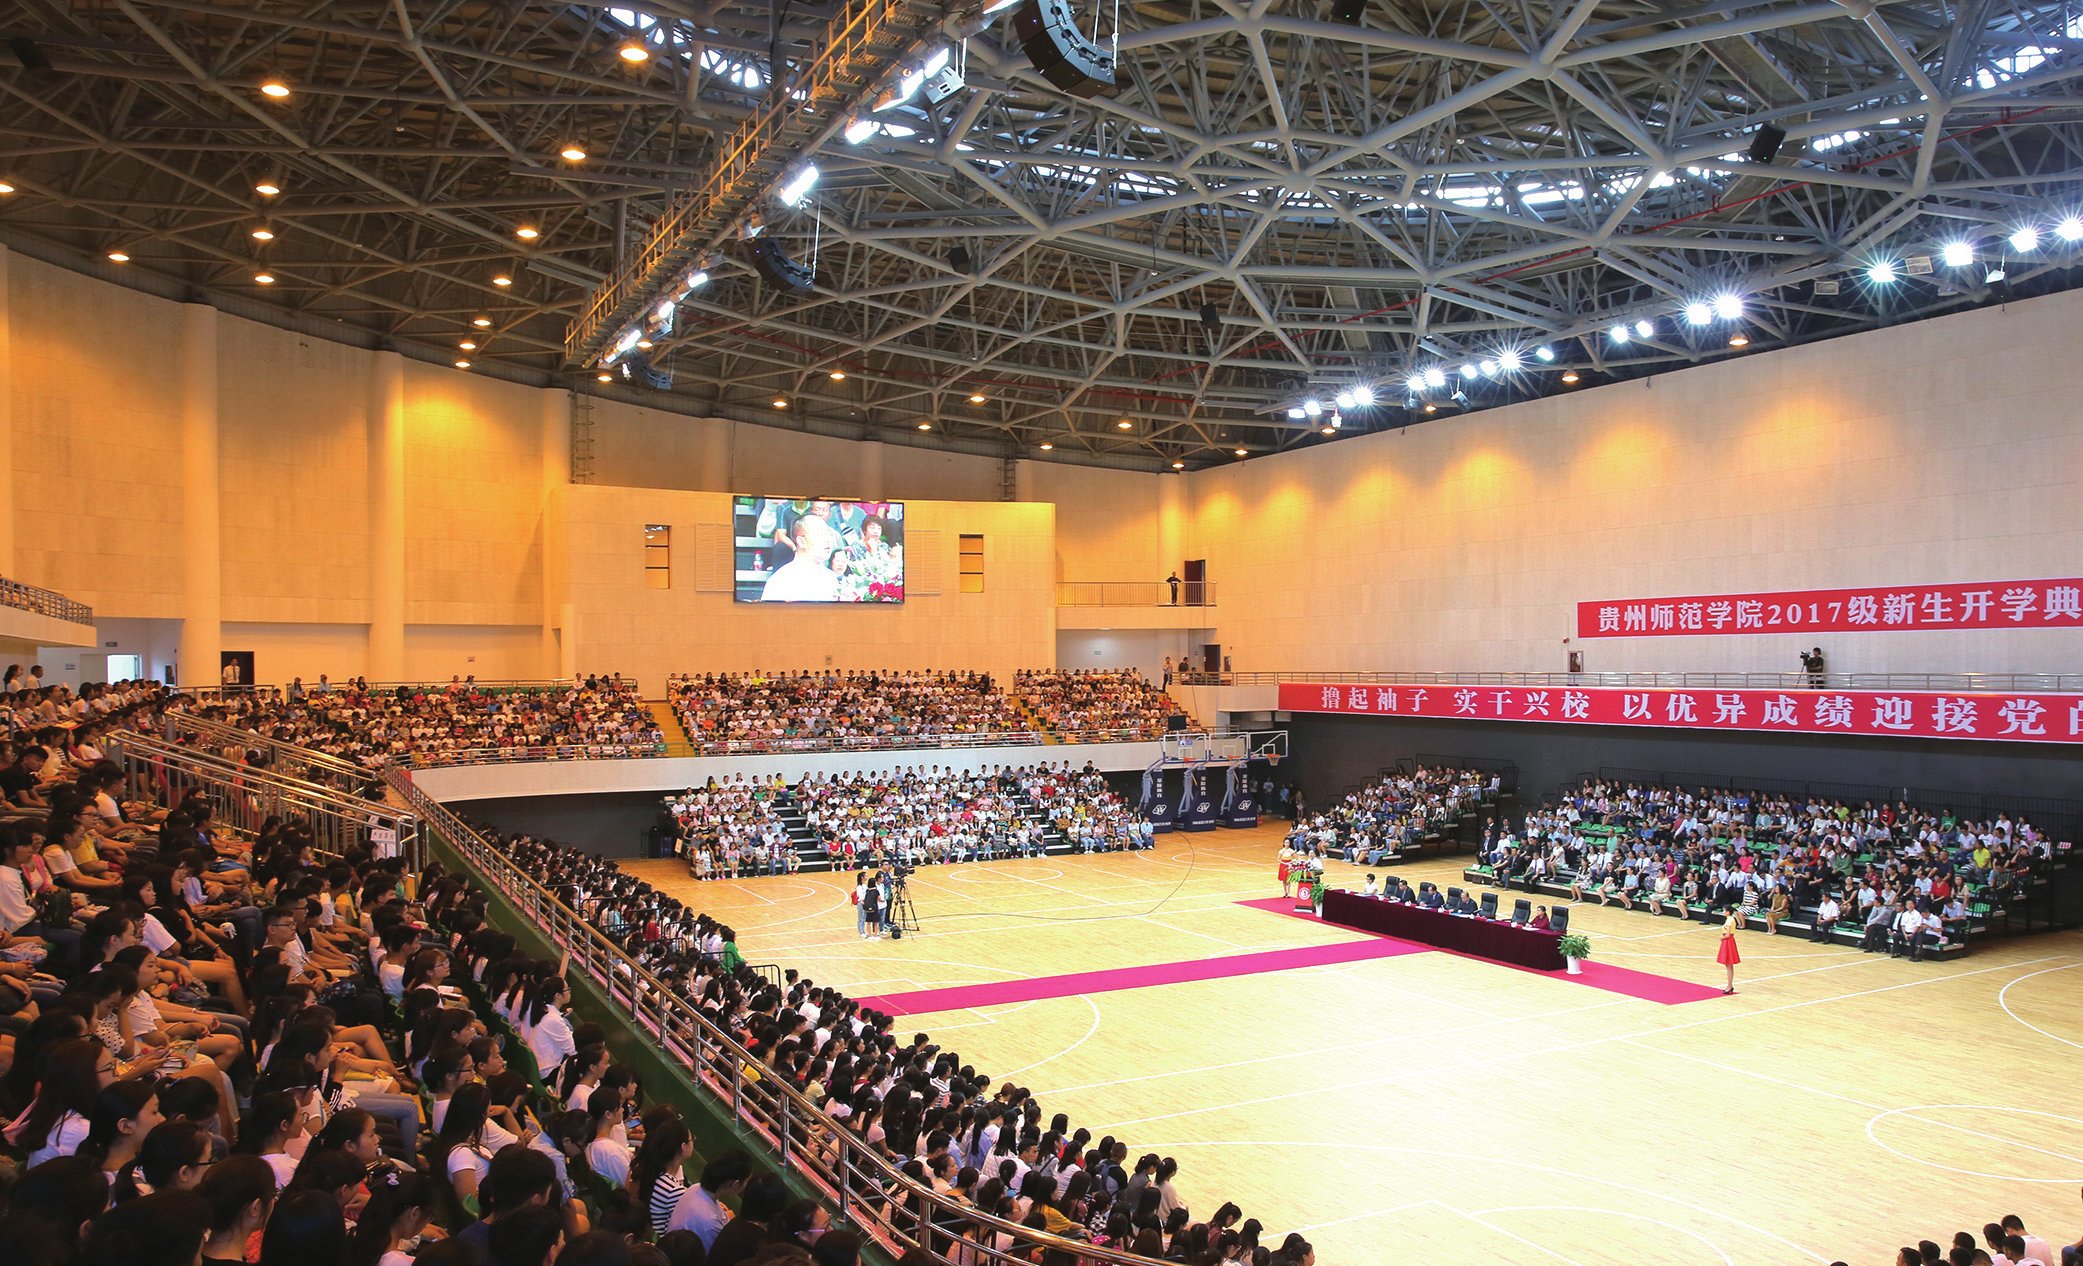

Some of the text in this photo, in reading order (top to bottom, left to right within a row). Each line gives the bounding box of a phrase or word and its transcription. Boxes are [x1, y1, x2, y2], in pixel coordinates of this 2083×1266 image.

[1598, 587, 2083, 632] 贵州师范学院2017级新生开学典
[1321, 686, 1430, 713] 撸起袖子
[1453, 689, 1592, 720] 实干兴校
